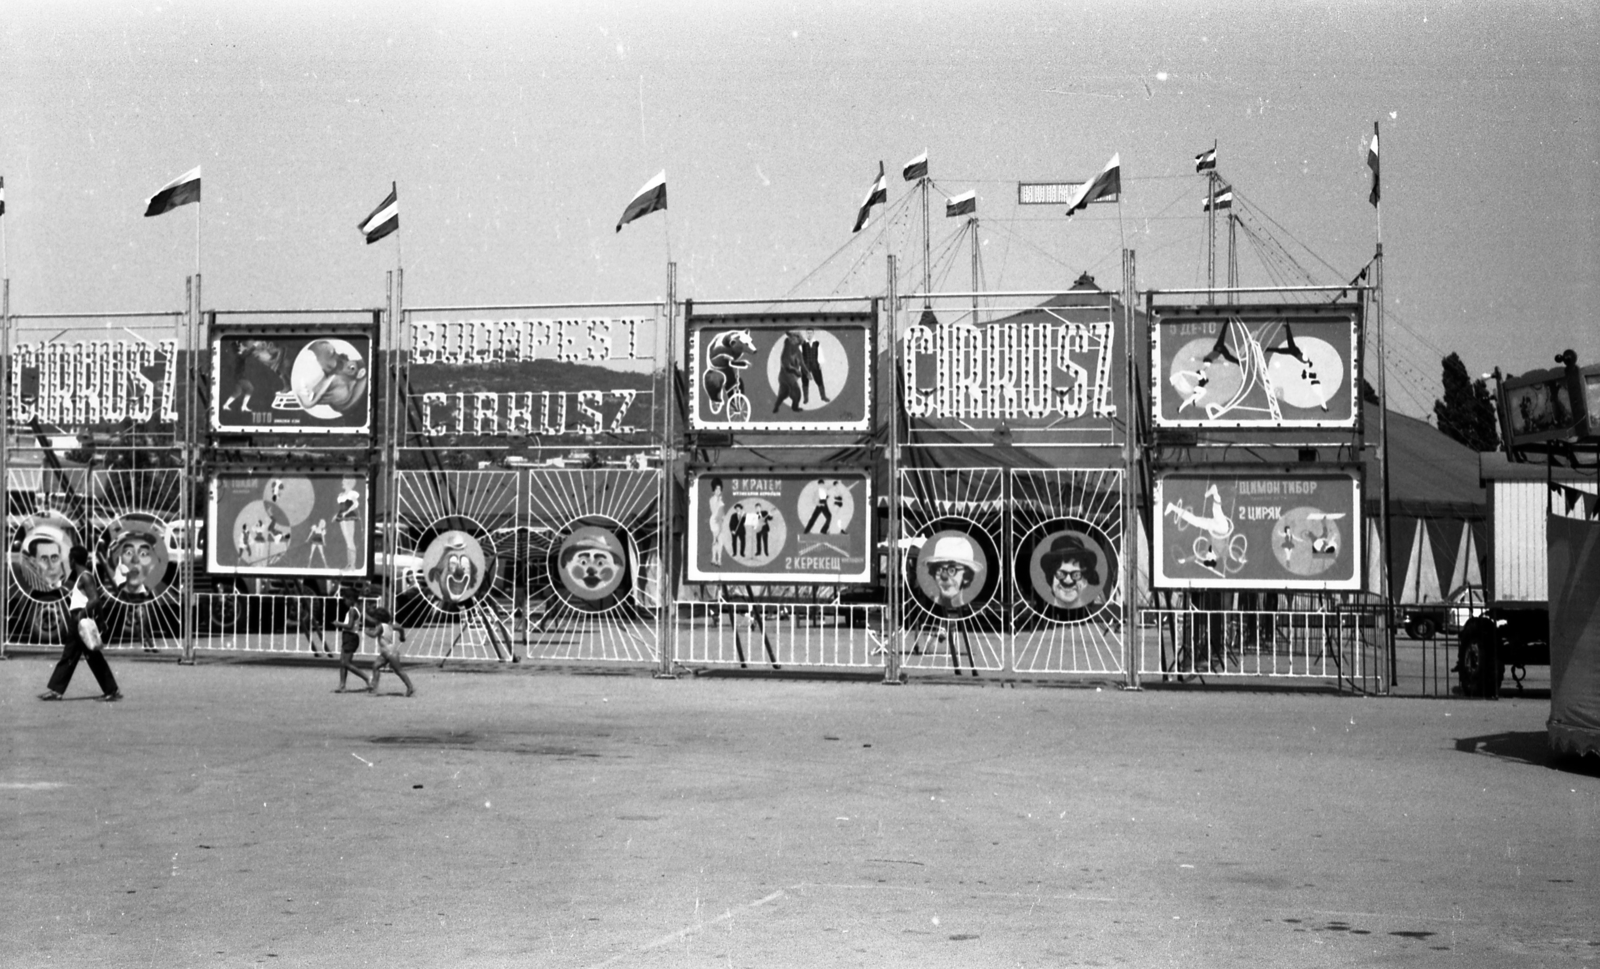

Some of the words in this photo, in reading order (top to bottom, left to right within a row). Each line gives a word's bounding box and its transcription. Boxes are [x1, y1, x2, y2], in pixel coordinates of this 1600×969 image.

[411, 317, 643, 364] BUDAPEST
[12, 339, 178, 424] CIRKUSZ
[904, 322, 1116, 418] CIRKUSZ
[423, 389, 636, 436] CIRKUSZ
[1283, 481, 1318, 494] ТИБОР
[1239, 506, 1247, 519] 2
[1249, 506, 1282, 520] ЦИРЯК
[785, 557, 793, 569] 2
